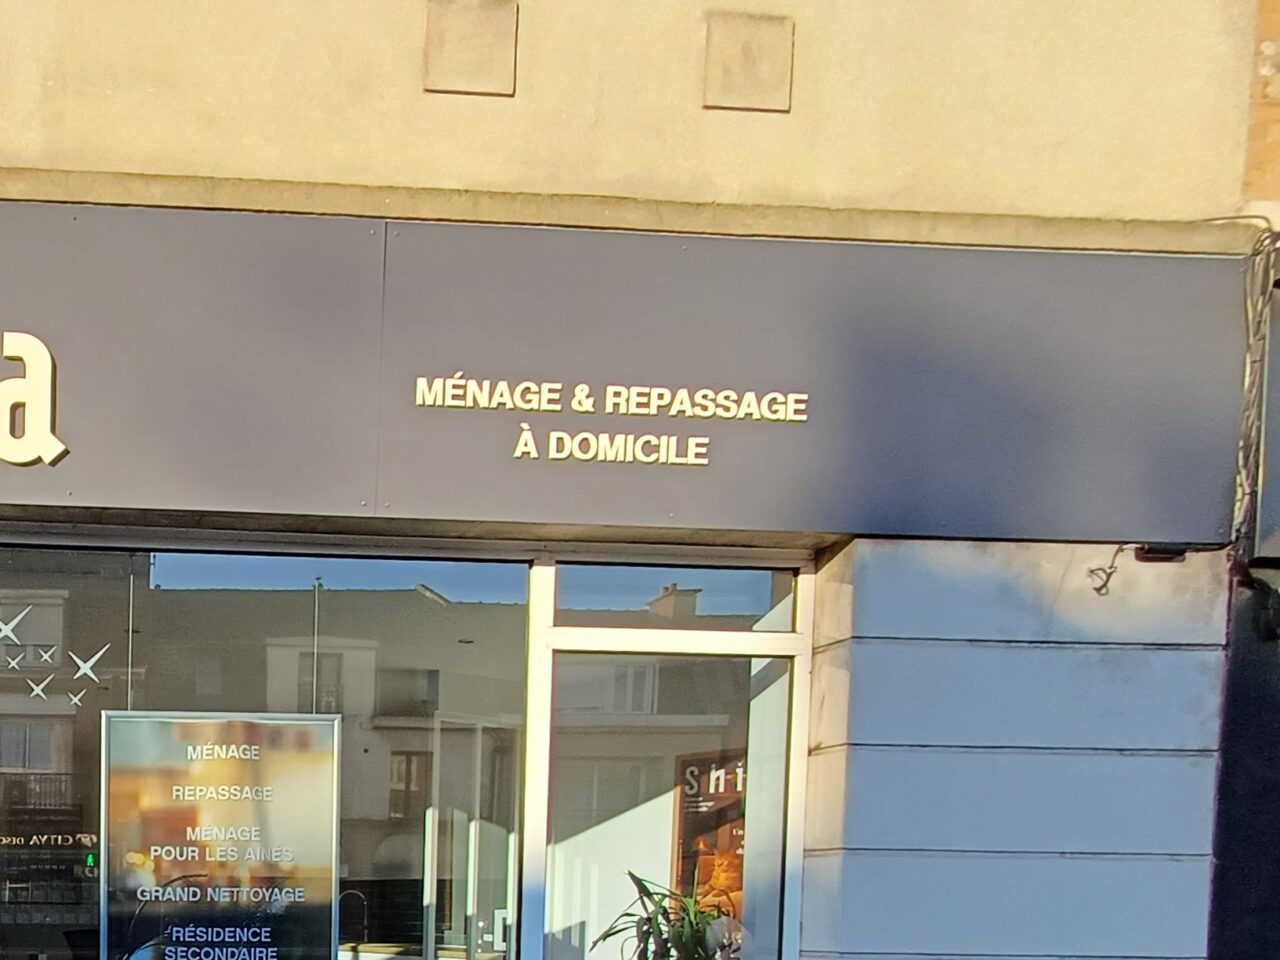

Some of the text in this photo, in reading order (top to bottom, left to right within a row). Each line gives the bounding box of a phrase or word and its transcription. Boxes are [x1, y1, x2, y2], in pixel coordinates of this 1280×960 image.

[415, 371, 808, 422] MÉNAGE & REPASSAGE
[513, 423, 710, 465] À DOMICILE
[187, 741, 260, 760] MÉNAGE
[172, 785, 273, 801] REPASSAGE
[186, 825, 261, 841] MÉNAGE
[150, 844, 294, 862] POUR LES AINÉS
[137, 886, 305, 902] GRAND NETTOYAGE
[172, 924, 271, 942] RÉSIDENCE
